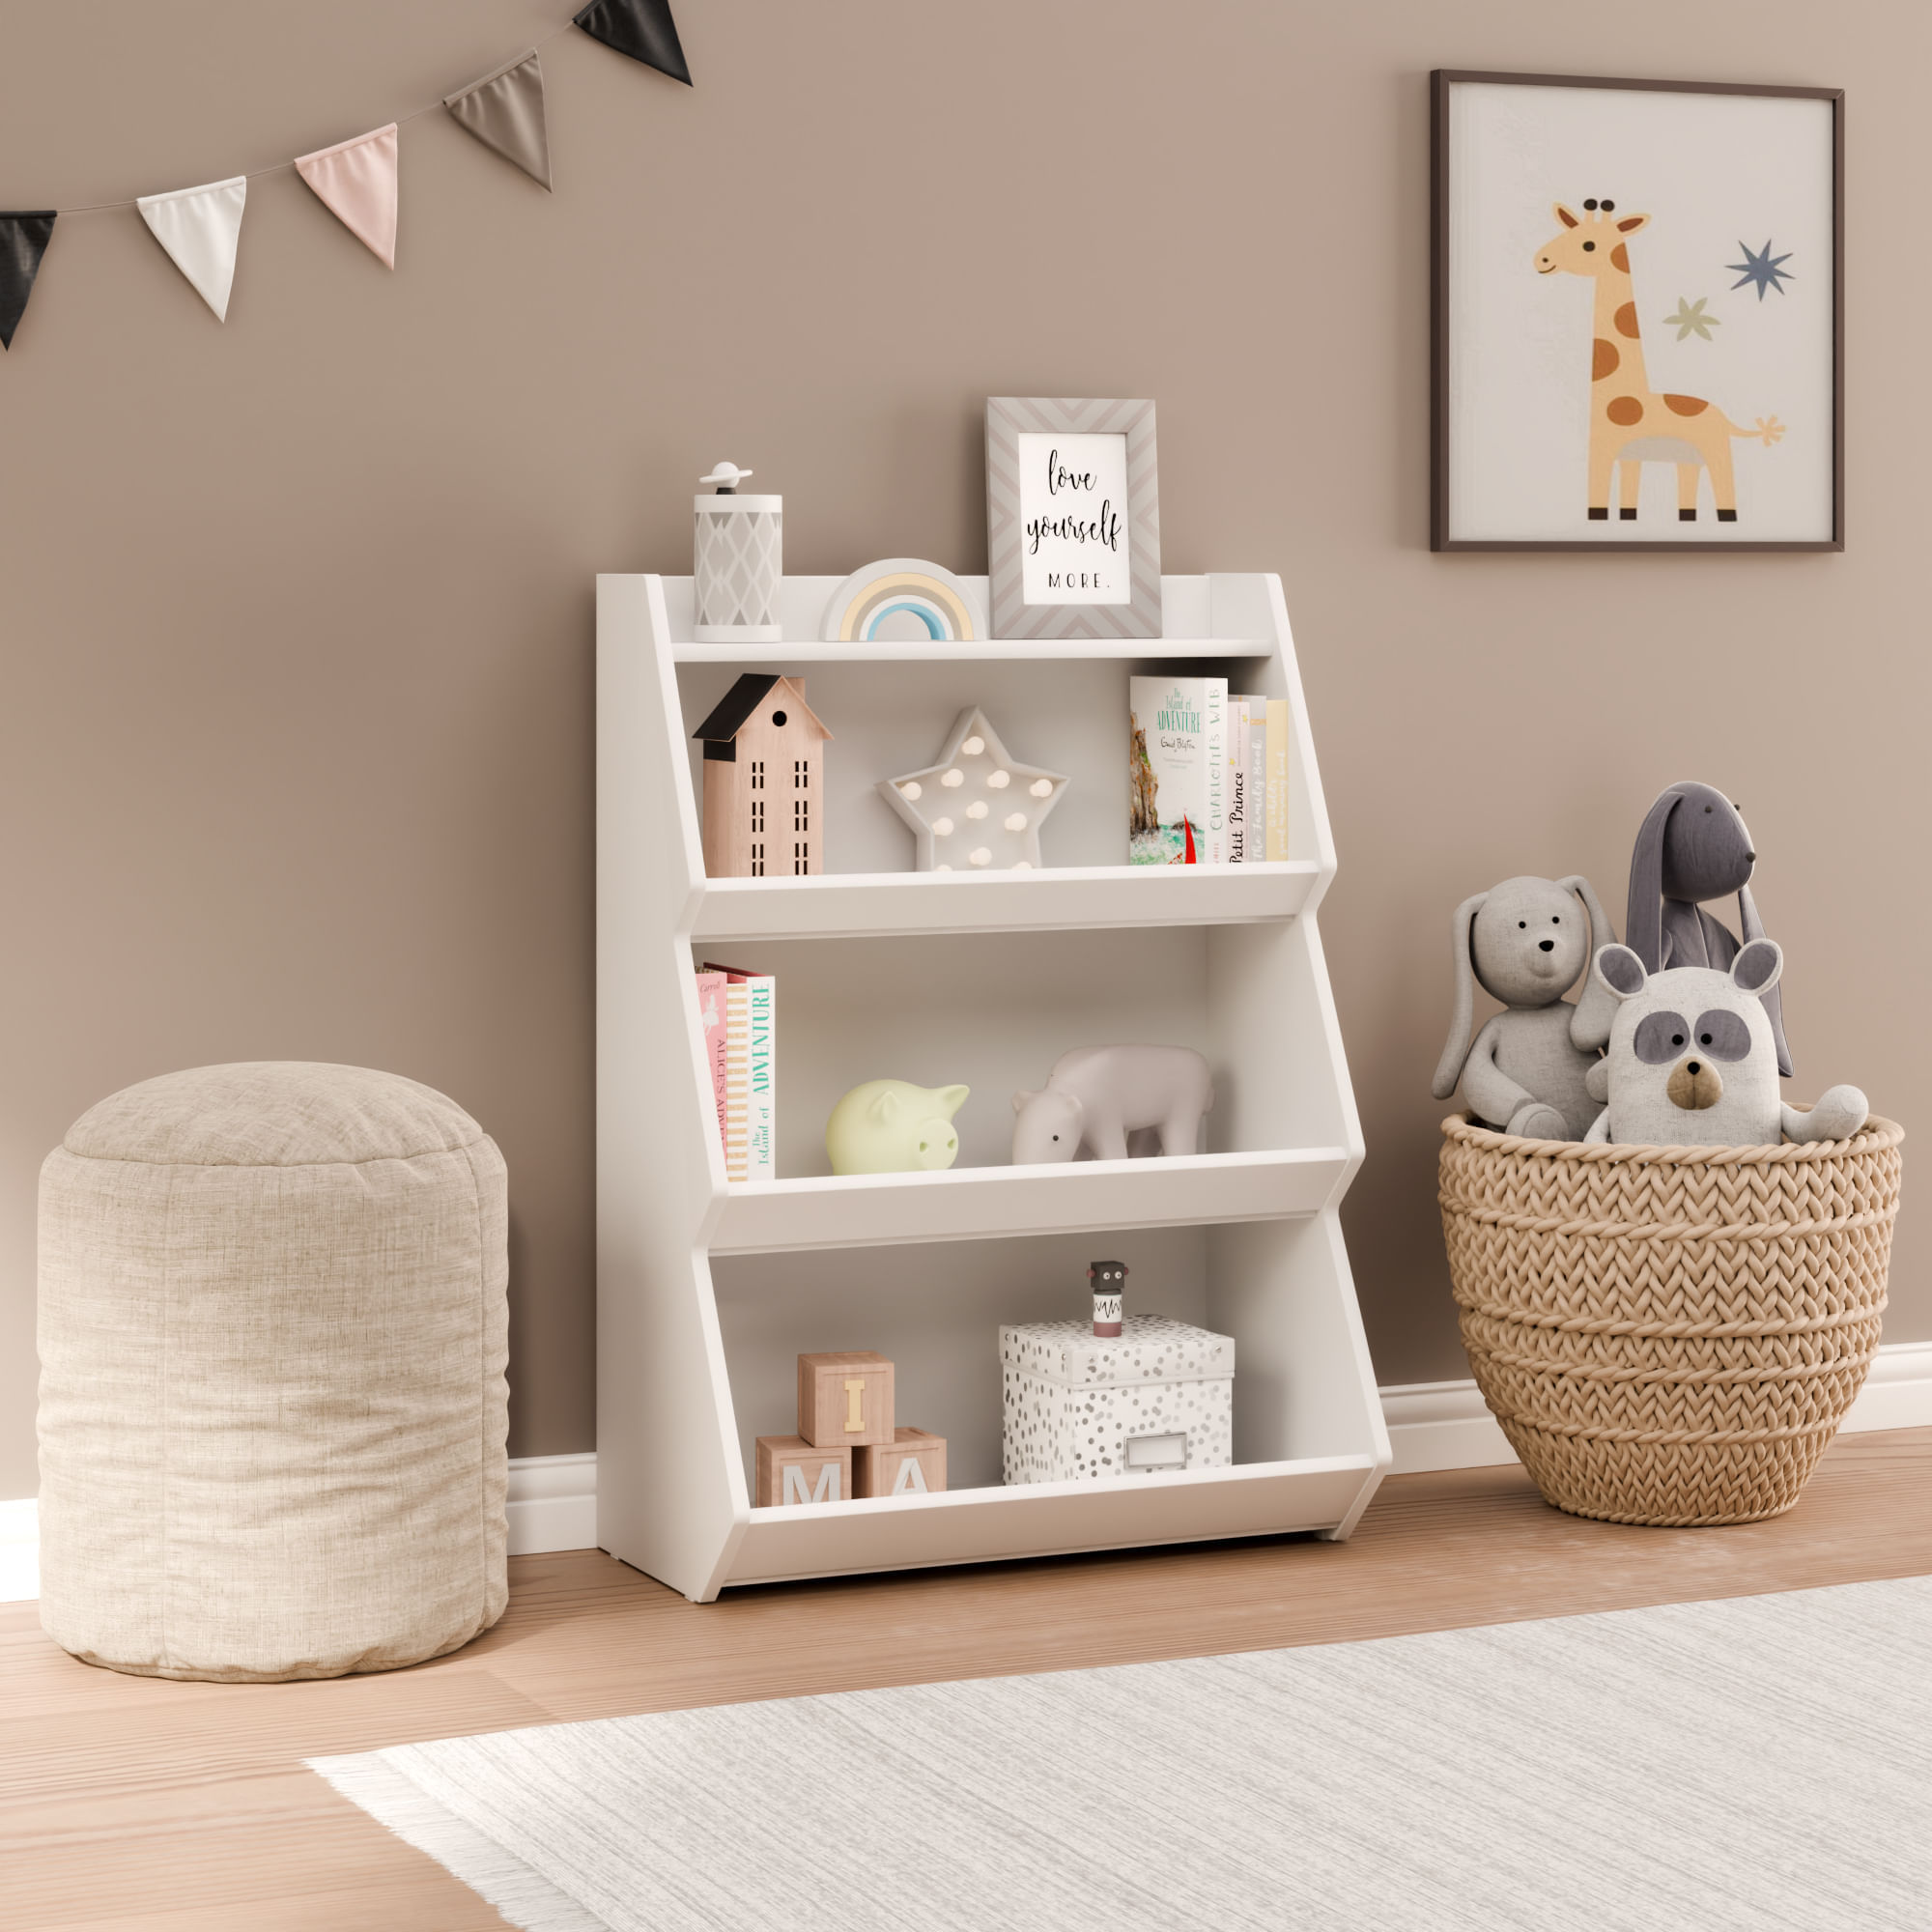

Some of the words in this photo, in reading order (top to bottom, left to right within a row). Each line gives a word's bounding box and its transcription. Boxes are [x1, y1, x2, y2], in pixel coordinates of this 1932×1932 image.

[1048, 448, 1097, 496] love
[1027, 498, 1122, 555] yourself
[1048, 572, 1110, 588] MORE.
[1157, 710, 1201, 734] ADVENTURE
[1208, 688, 1221, 724] WEB
[1229, 772, 1243, 825] Prince
[1229, 830, 1243, 864] Petit
[752, 983, 771, 1095] ADVENTURE
[752, 1132, 761, 1147] The
[757, 1125, 770, 1165] Island
[843, 1378, 866, 1434] I
[782, 1463, 841, 1506] M
[892, 1457, 928, 1496] A
